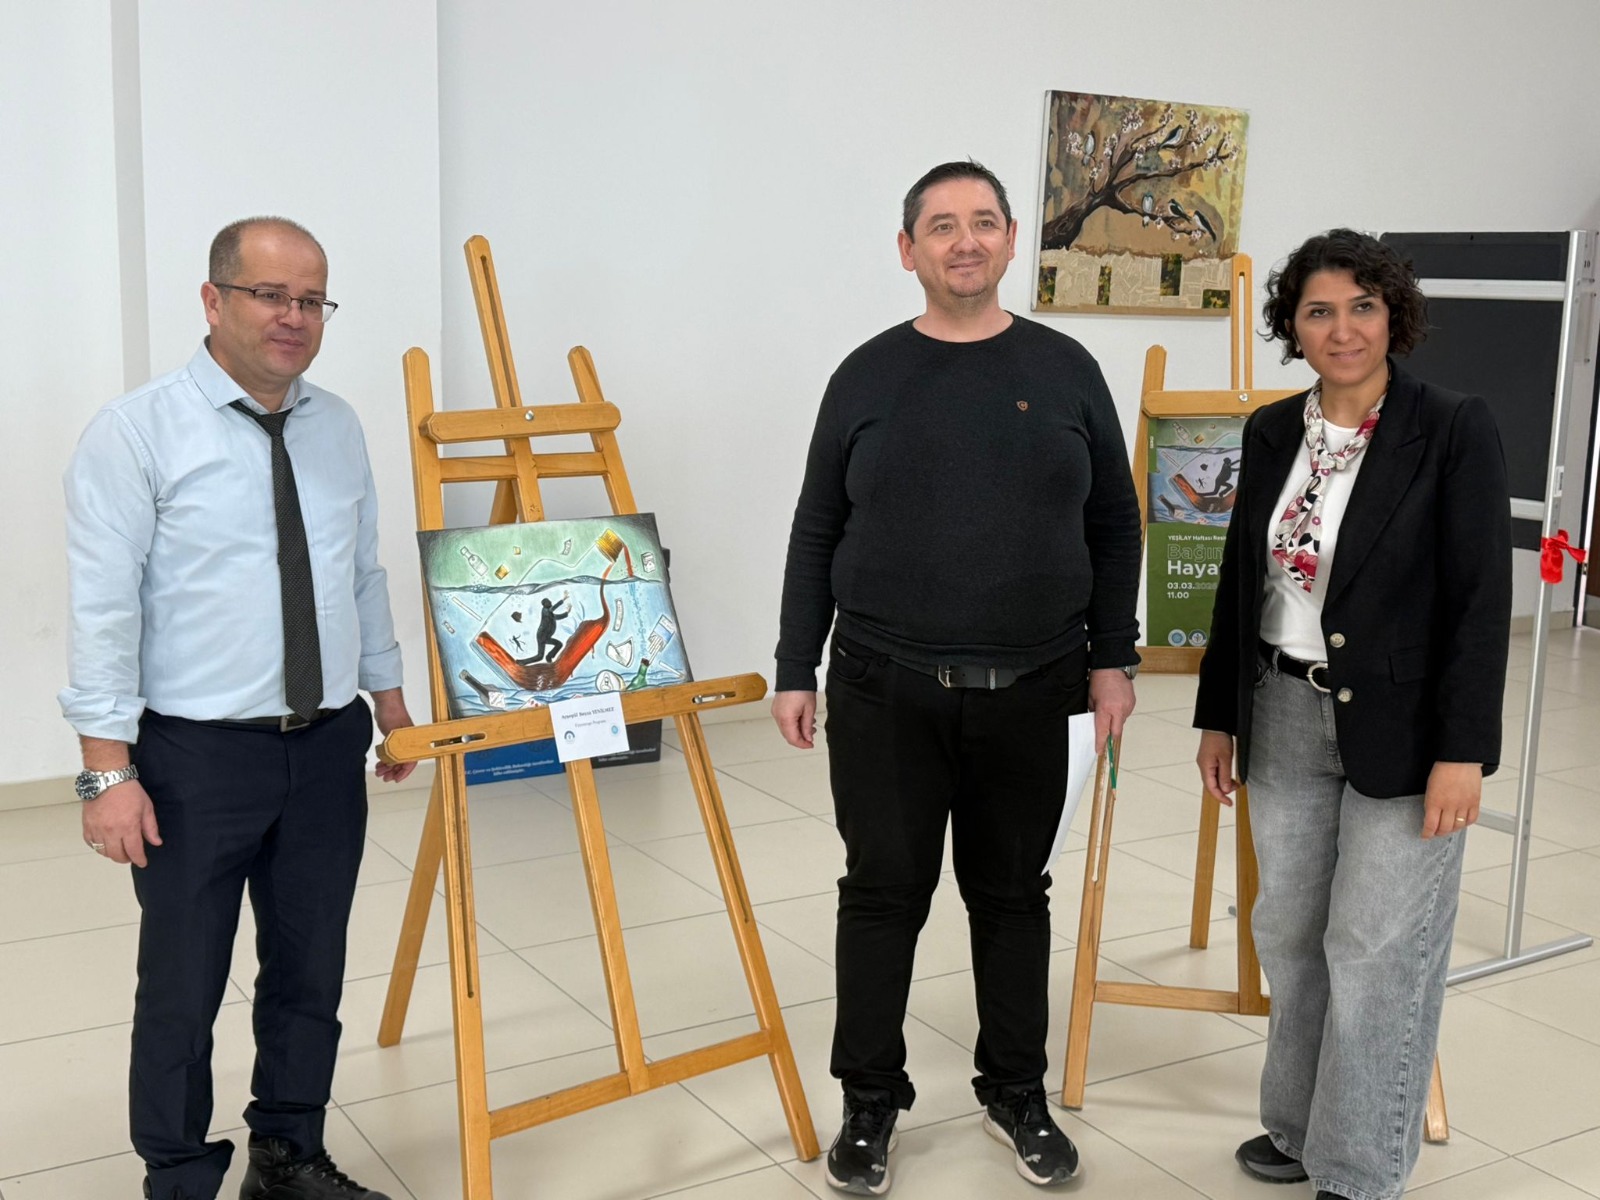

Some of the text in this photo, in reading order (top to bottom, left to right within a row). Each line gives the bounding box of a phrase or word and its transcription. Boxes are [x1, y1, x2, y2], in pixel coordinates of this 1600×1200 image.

[1168, 534, 1191, 542] YEŞİLAY
[1167, 560, 1222, 579] Haya
[1167, 591, 1190, 599] 11.00
